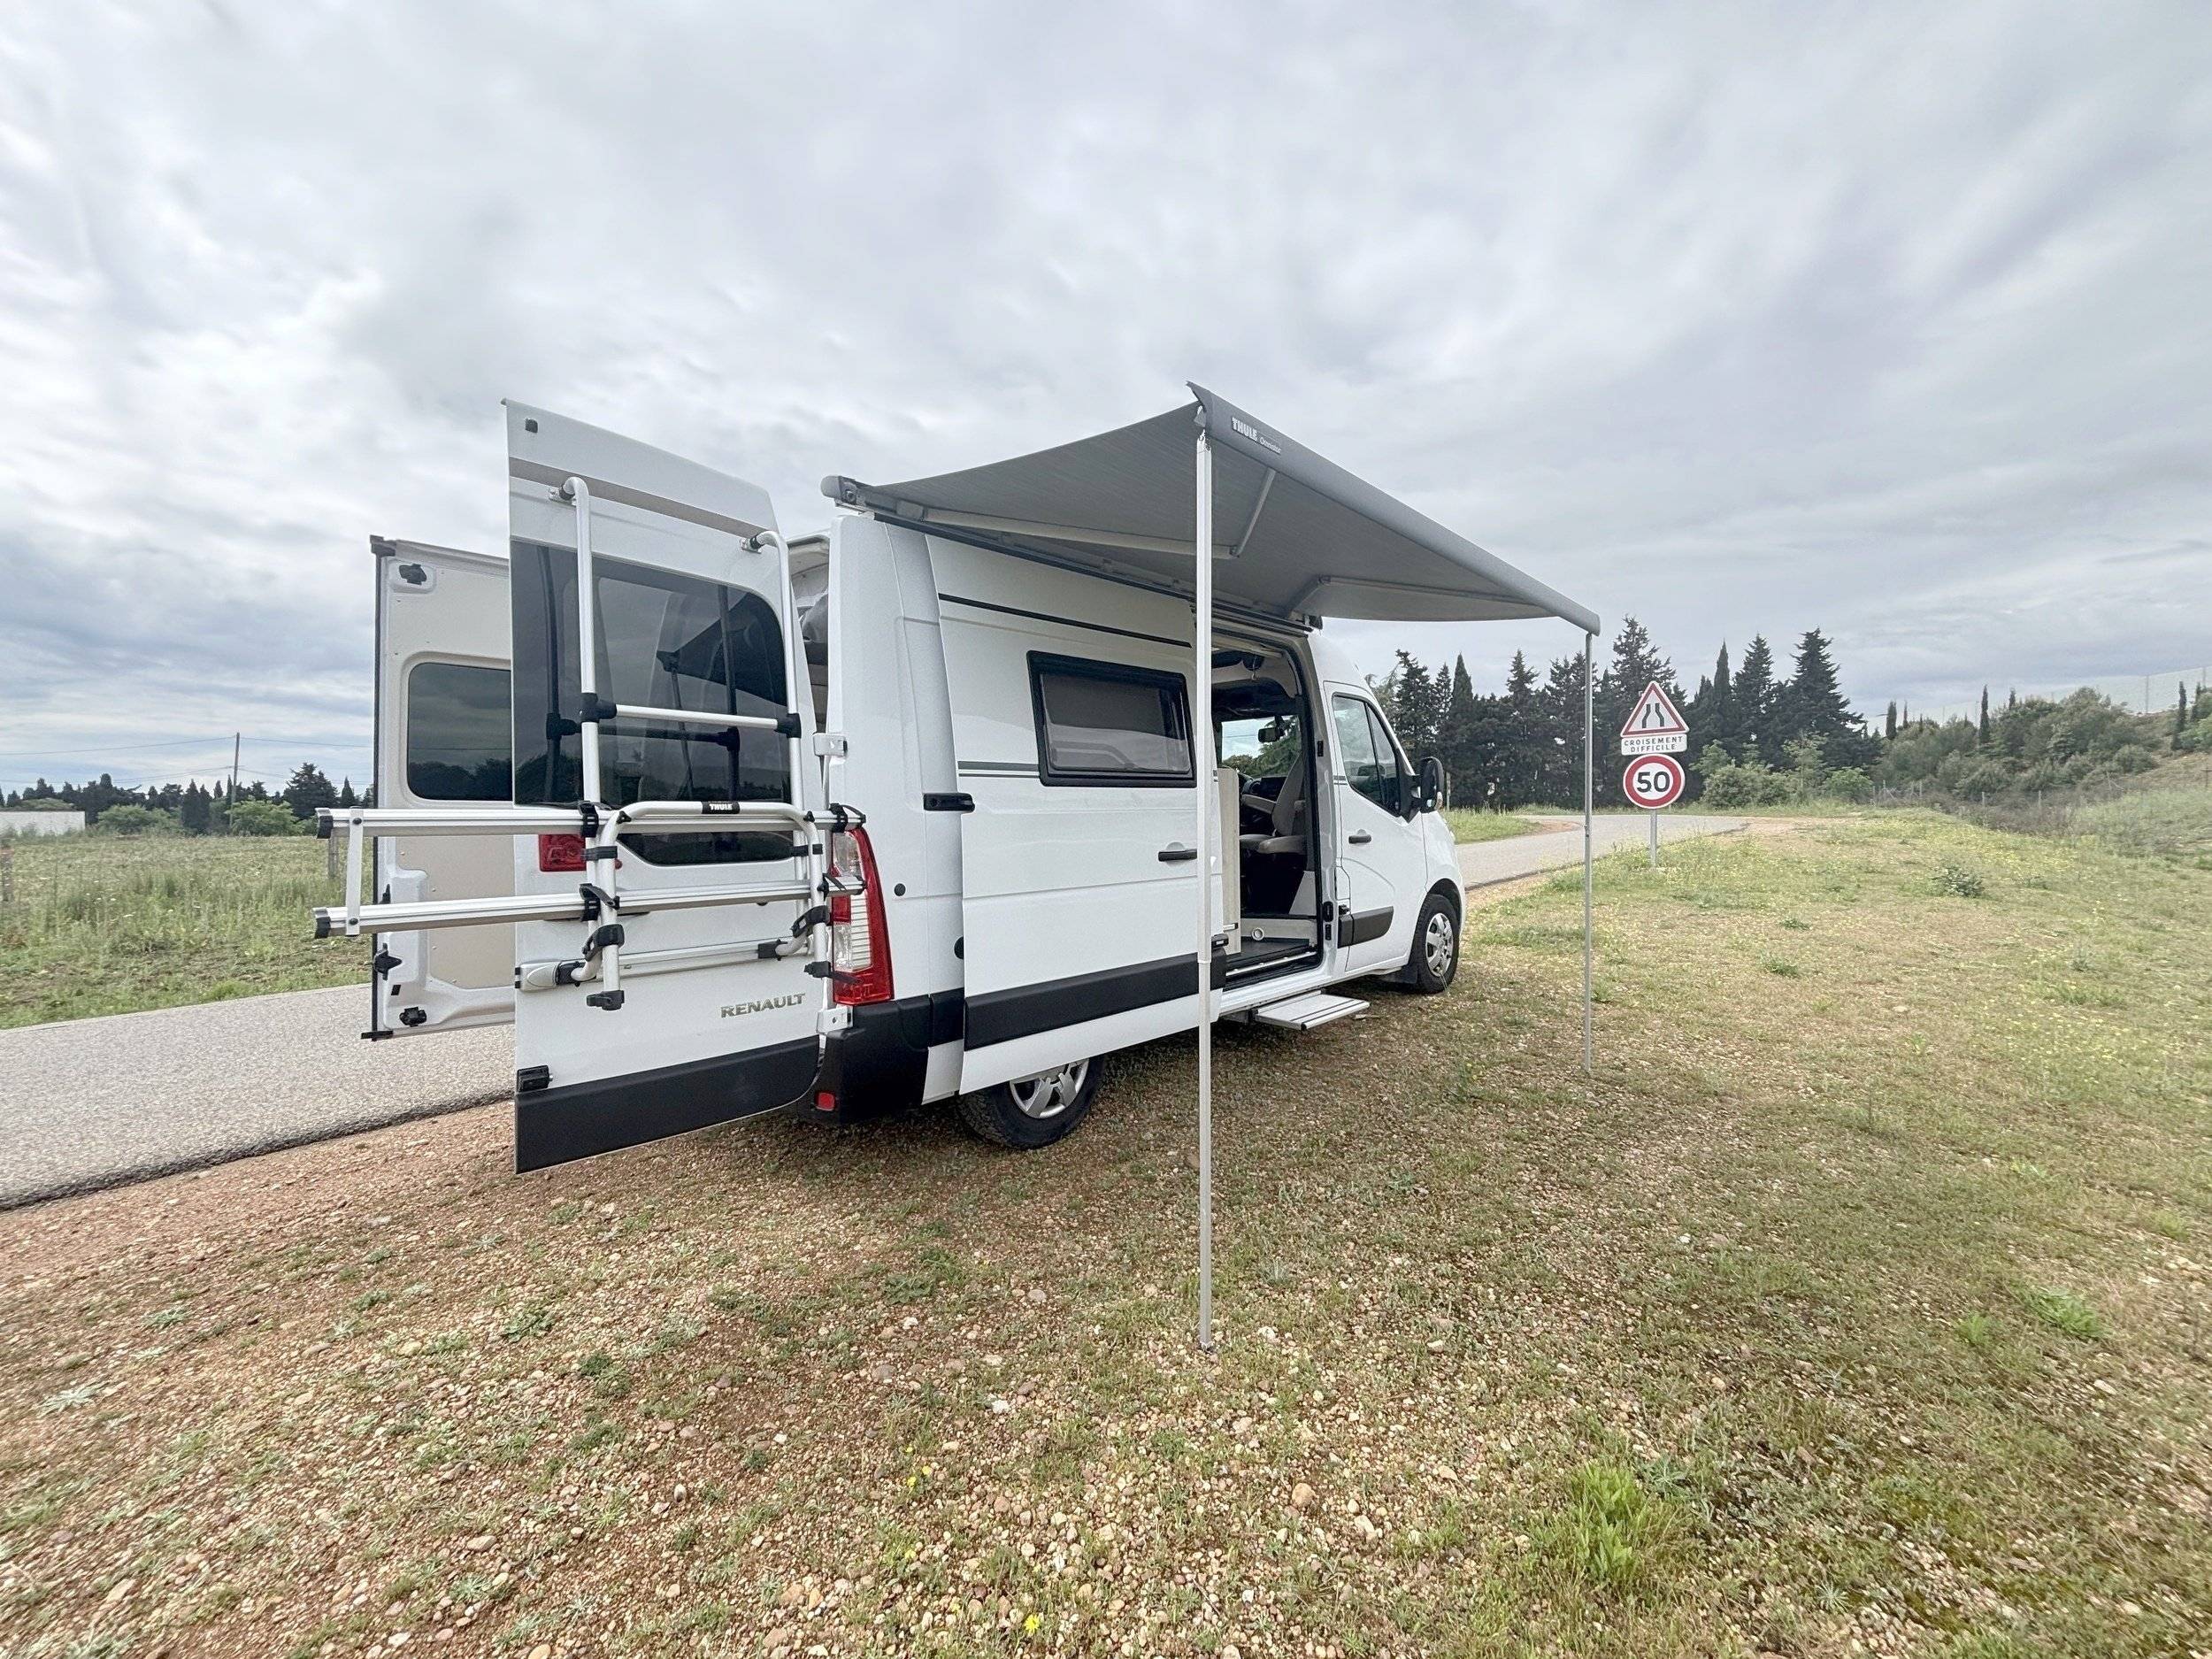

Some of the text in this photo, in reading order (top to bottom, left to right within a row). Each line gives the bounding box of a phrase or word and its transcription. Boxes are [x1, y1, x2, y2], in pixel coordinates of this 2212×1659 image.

[1231, 416, 1258, 442] THULE
[1624, 736, 1683, 746] CROISEMENT
[1637, 771, 1671, 793] 50
[720, 993, 805, 1018] RENAULT
